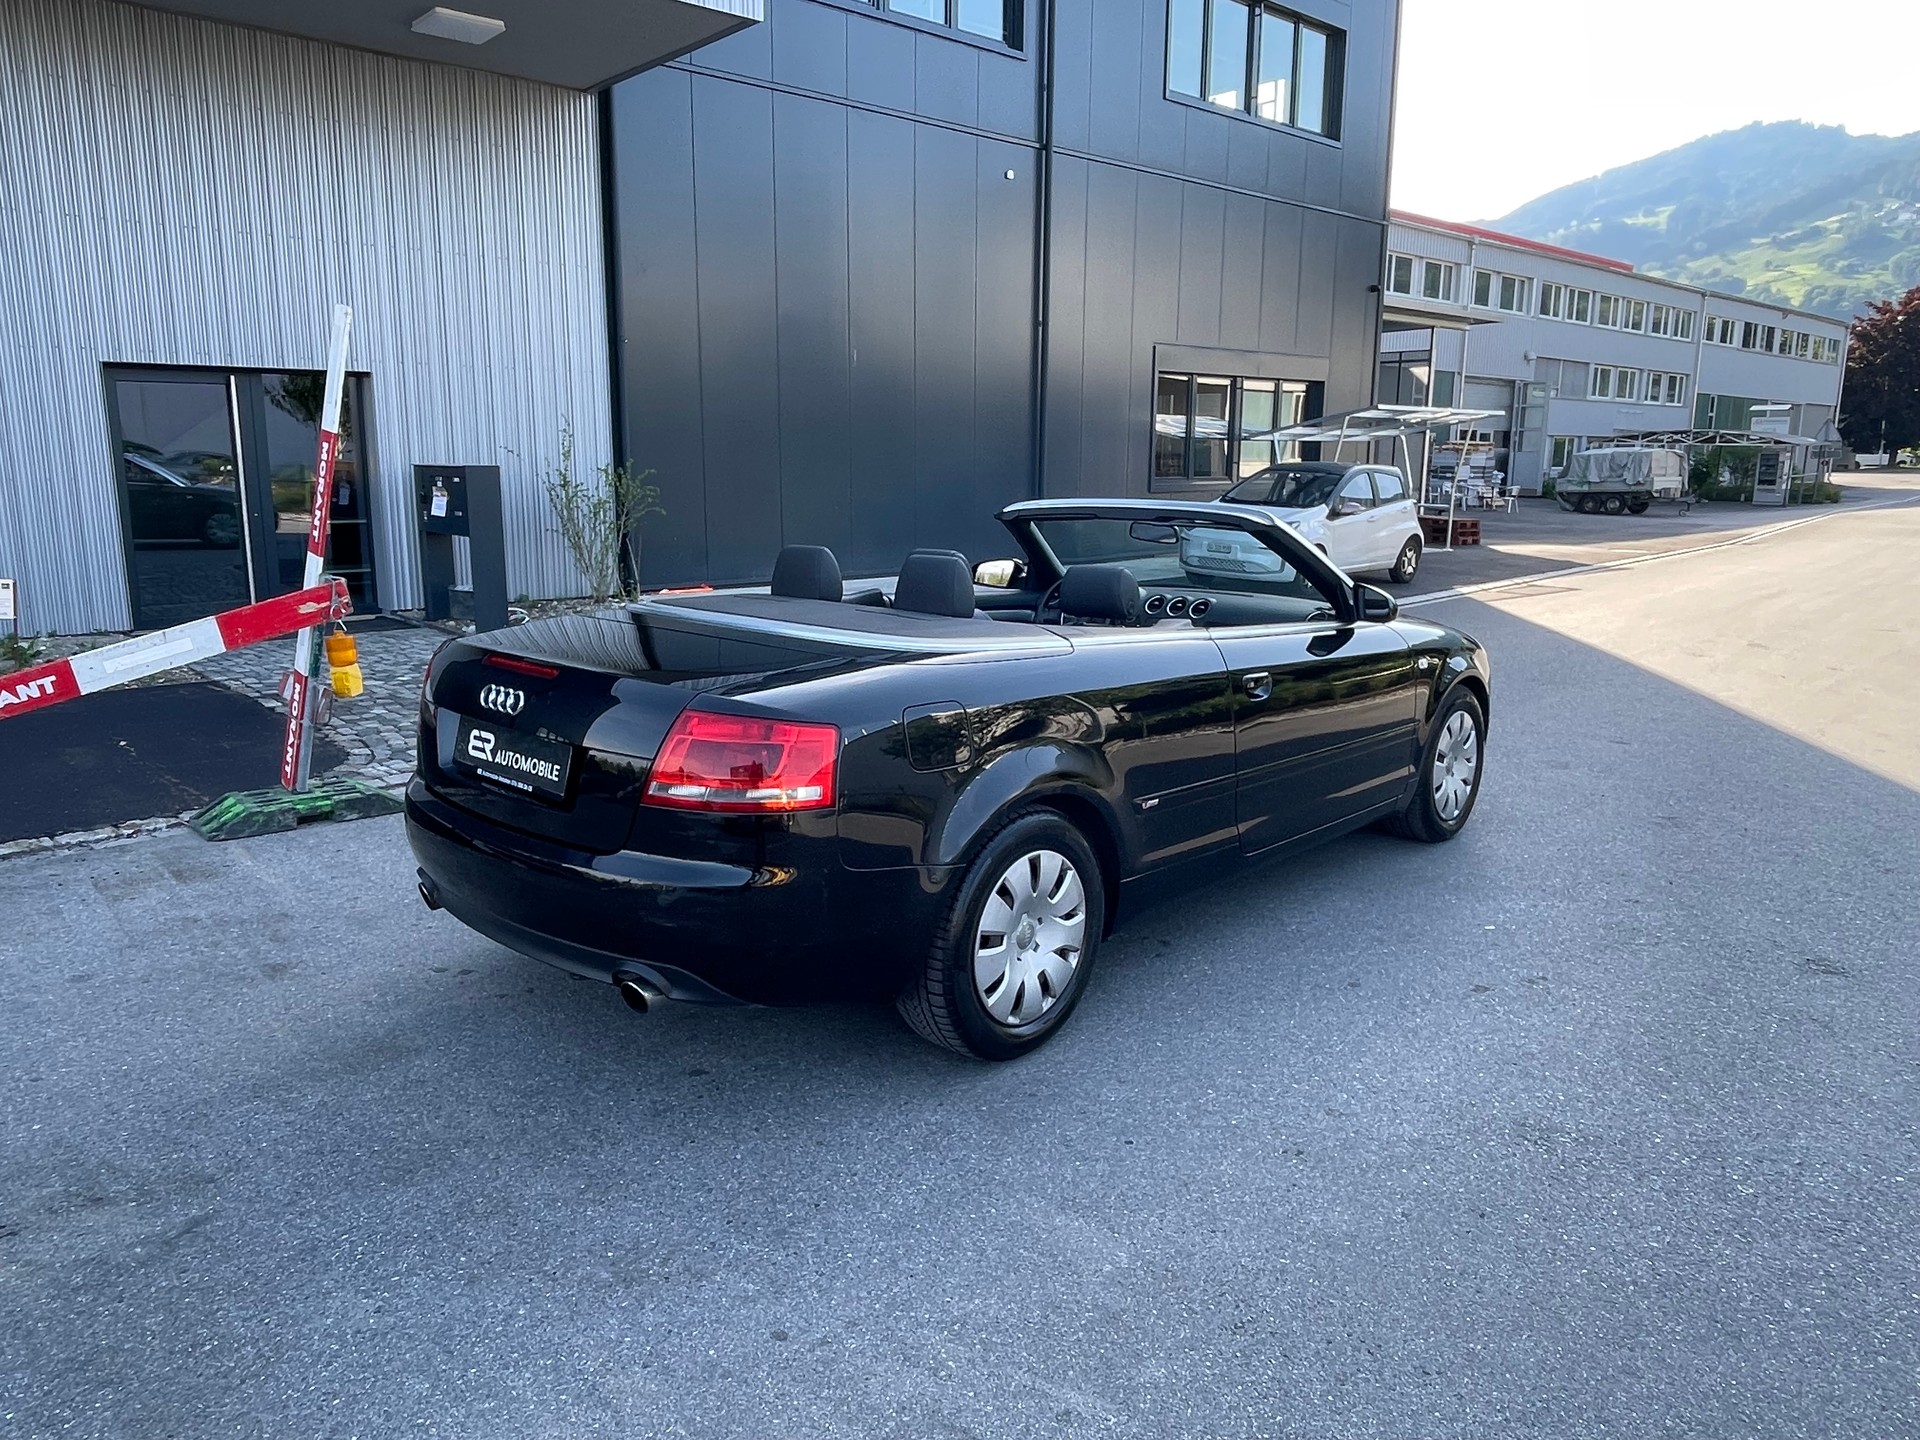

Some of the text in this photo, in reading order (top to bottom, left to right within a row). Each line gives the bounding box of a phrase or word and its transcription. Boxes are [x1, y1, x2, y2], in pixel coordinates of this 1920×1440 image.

[313, 442, 329, 543] MORANT
[284, 682, 301, 779] MORANT
[468, 728, 495, 762] ER
[494, 749, 561, 782] AUTOMOBILE
